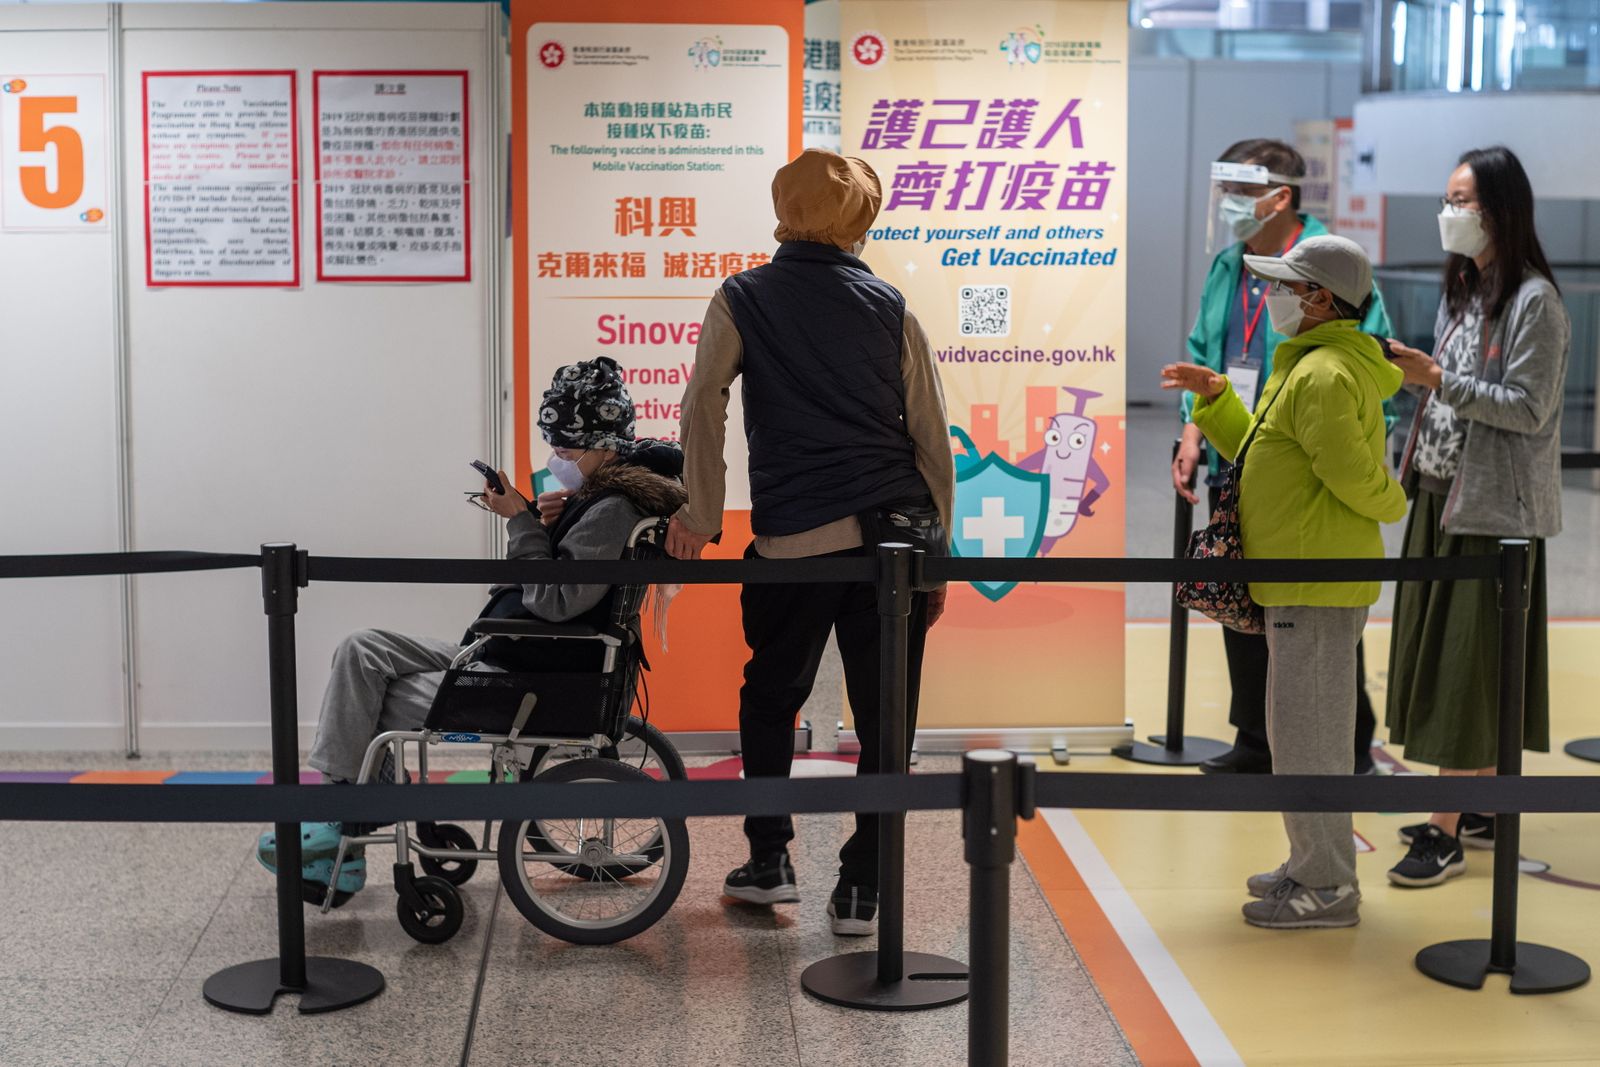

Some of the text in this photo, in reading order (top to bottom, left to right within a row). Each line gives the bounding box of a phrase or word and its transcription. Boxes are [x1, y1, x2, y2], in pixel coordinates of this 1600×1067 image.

[583, 102, 733, 119] 本流動接種站為市民
[860, 98, 1084, 150] 護己護人
[19, 96, 85, 209] 5
[550, 145, 764, 157] The following vaccine is administered in this
[592, 161, 725, 171] Mobile Vaccination Station:
[885, 160, 1116, 211] 齊打疫苗
[614, 197, 697, 237] 科興
[924, 225, 1001, 243] yourself
[1005, 226, 1040, 240] and
[1046, 225, 1104, 240] others
[537, 252, 646, 278] 克爾來福
[940, 248, 1118, 267] Get Vaccinated
[934, 346, 1116, 365] vidvaccine.gov.hk
